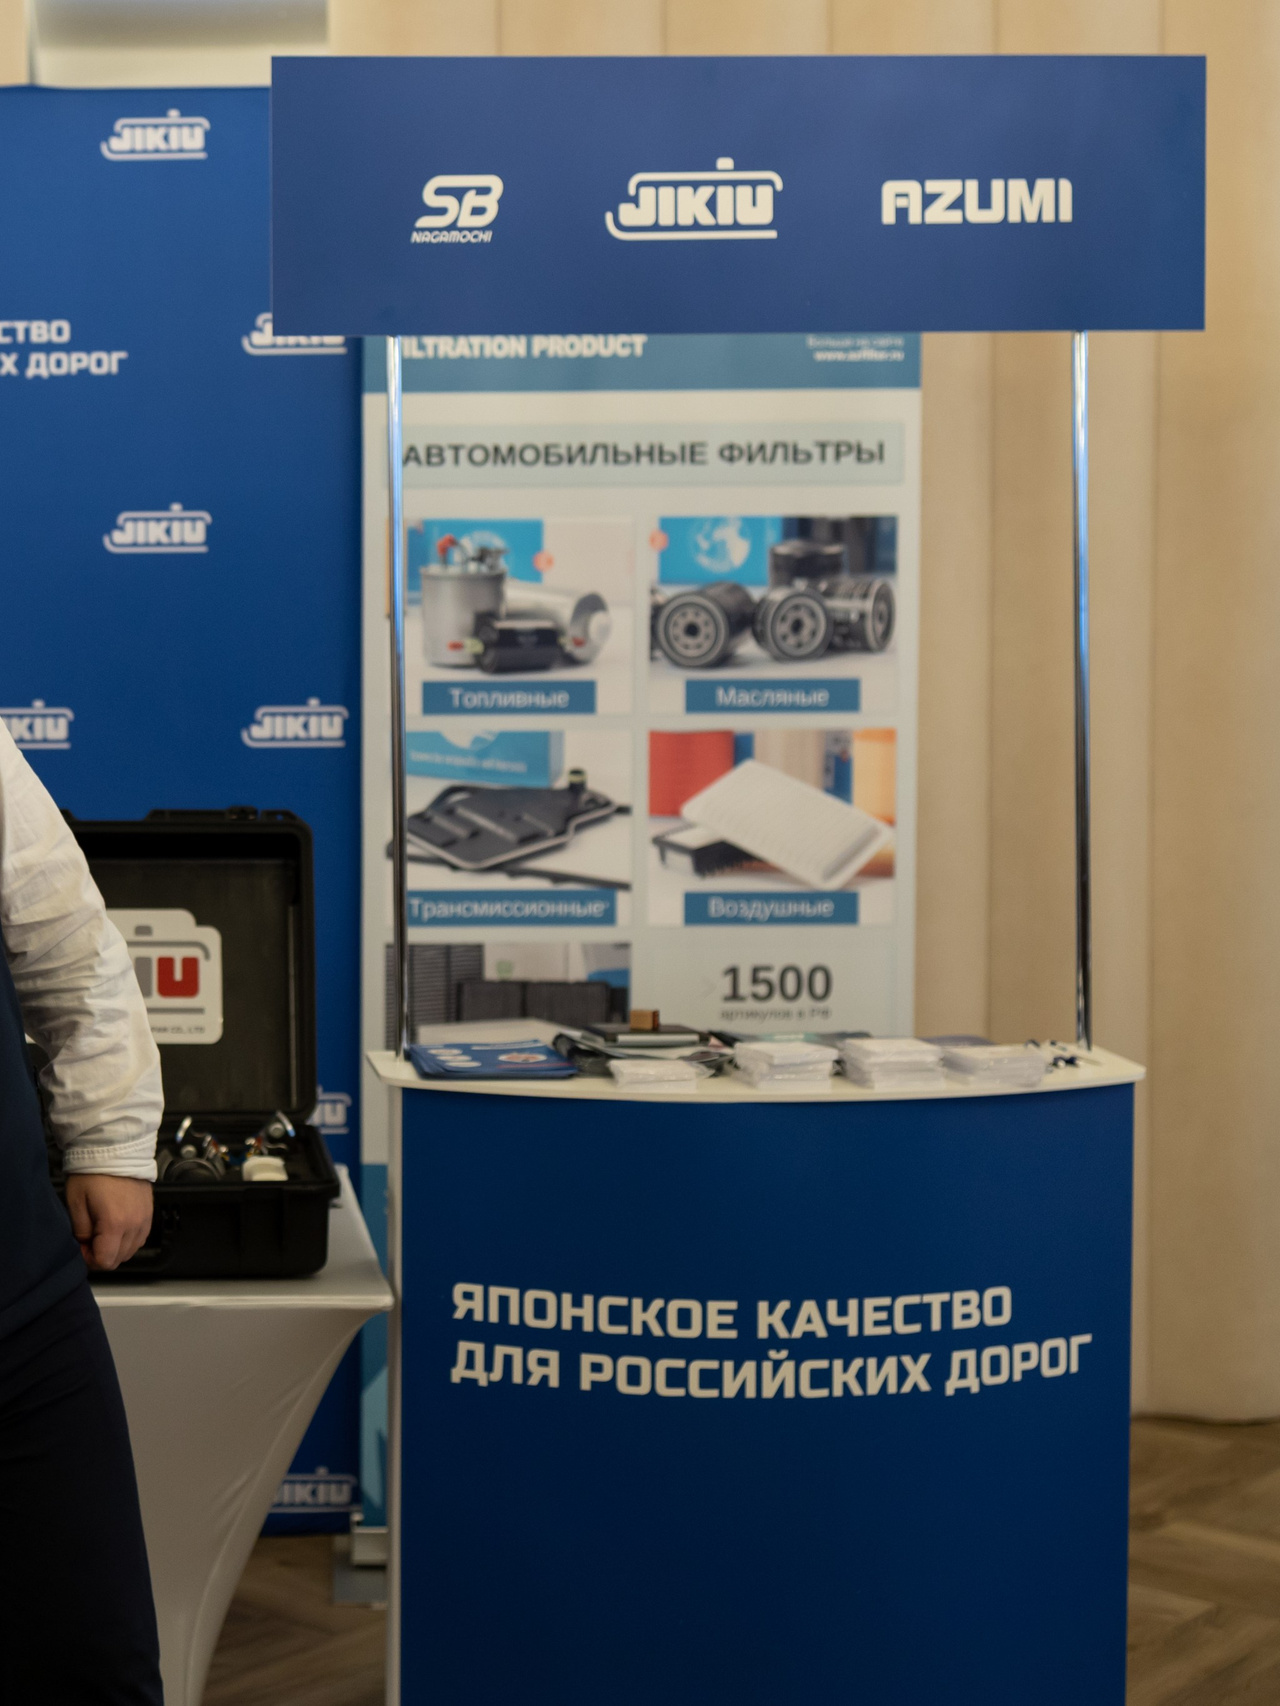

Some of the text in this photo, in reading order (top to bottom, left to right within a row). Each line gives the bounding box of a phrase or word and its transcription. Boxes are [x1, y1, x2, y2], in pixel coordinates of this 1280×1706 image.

[108, 108, 205, 153] JIKIU
[415, 175, 504, 228] SB
[618, 157, 775, 227] JIKIU
[881, 178, 1073, 224] AZUMI
[410, 230, 493, 243] NAGAMOCHI
[25, 351, 128, 379] ДОРОГ
[404, 334, 649, 359] ILTRATION PRODUCT
[401, 440, 885, 467] АВТОМОБИЛЬНЫЕ ФИЛЬТРЫ
[111, 503, 207, 546] JIKIU
[450, 687, 570, 709] Топливные
[716, 686, 830, 707] Масляные
[250, 697, 345, 740] JIKIU
[409, 898, 605, 921] Трансмиссионные
[708, 896, 834, 921] Воздушные
[723, 964, 833, 1002] 1500
[452, 1282, 1012, 1340] ЯПОНСКОЕ КАЧЕСТВО
[450, 1333, 1093, 1399] ДЛЯ РОССИЙСКИХ ДОРОГ
[276, 1467, 352, 1505] IKIU
